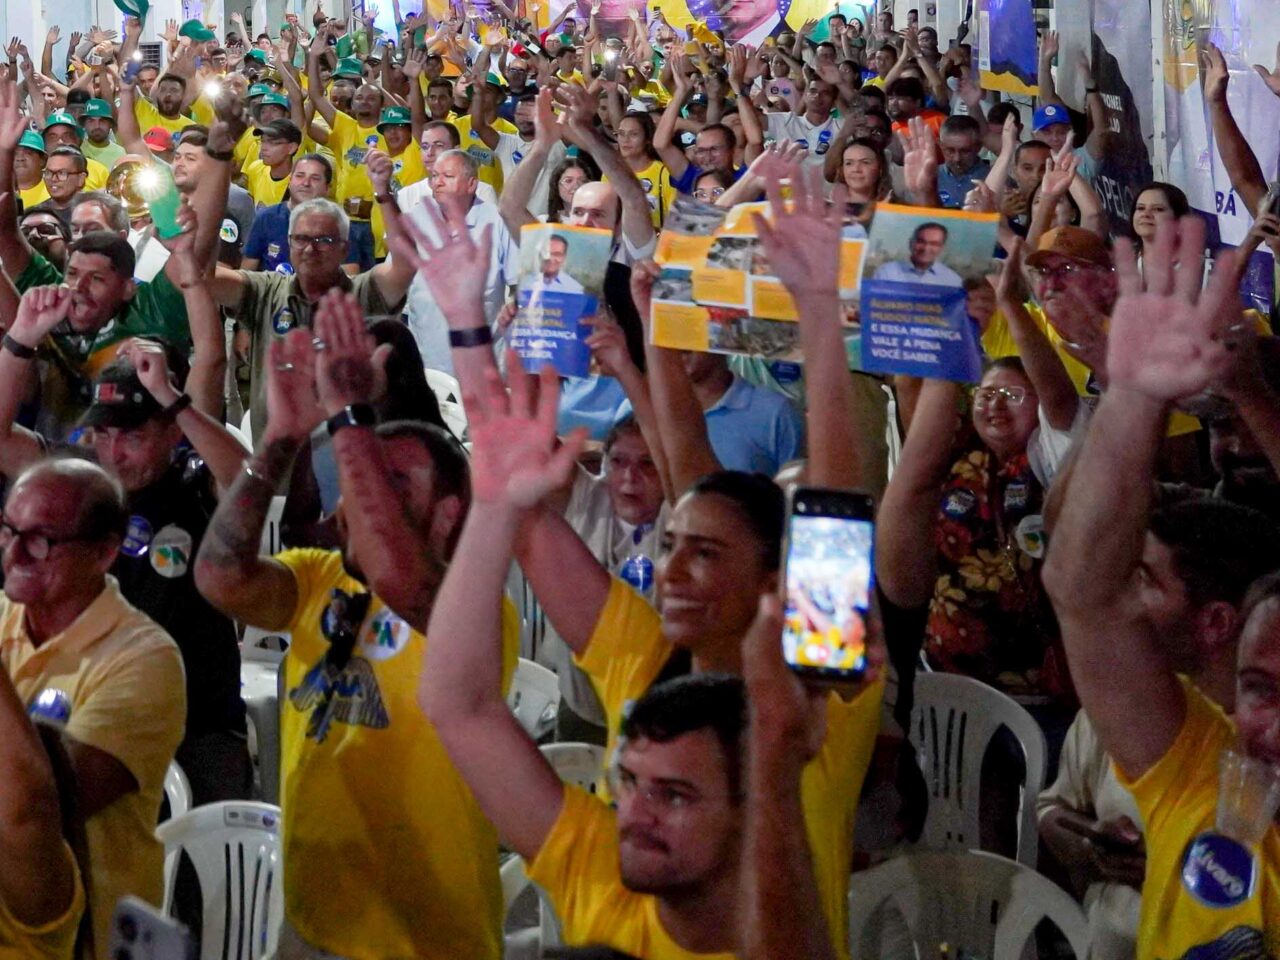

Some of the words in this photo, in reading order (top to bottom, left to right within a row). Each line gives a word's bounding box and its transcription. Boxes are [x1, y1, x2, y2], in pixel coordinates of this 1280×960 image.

[871, 323, 878, 332] E
[880, 324, 909, 334] ESSA
[910, 327, 962, 341] MUDANÇA
[871, 336, 898, 347] VALE
[903, 339, 912, 348] A
[913, 340, 942, 350] PENA
[871, 348, 900, 359] VOCÊ
